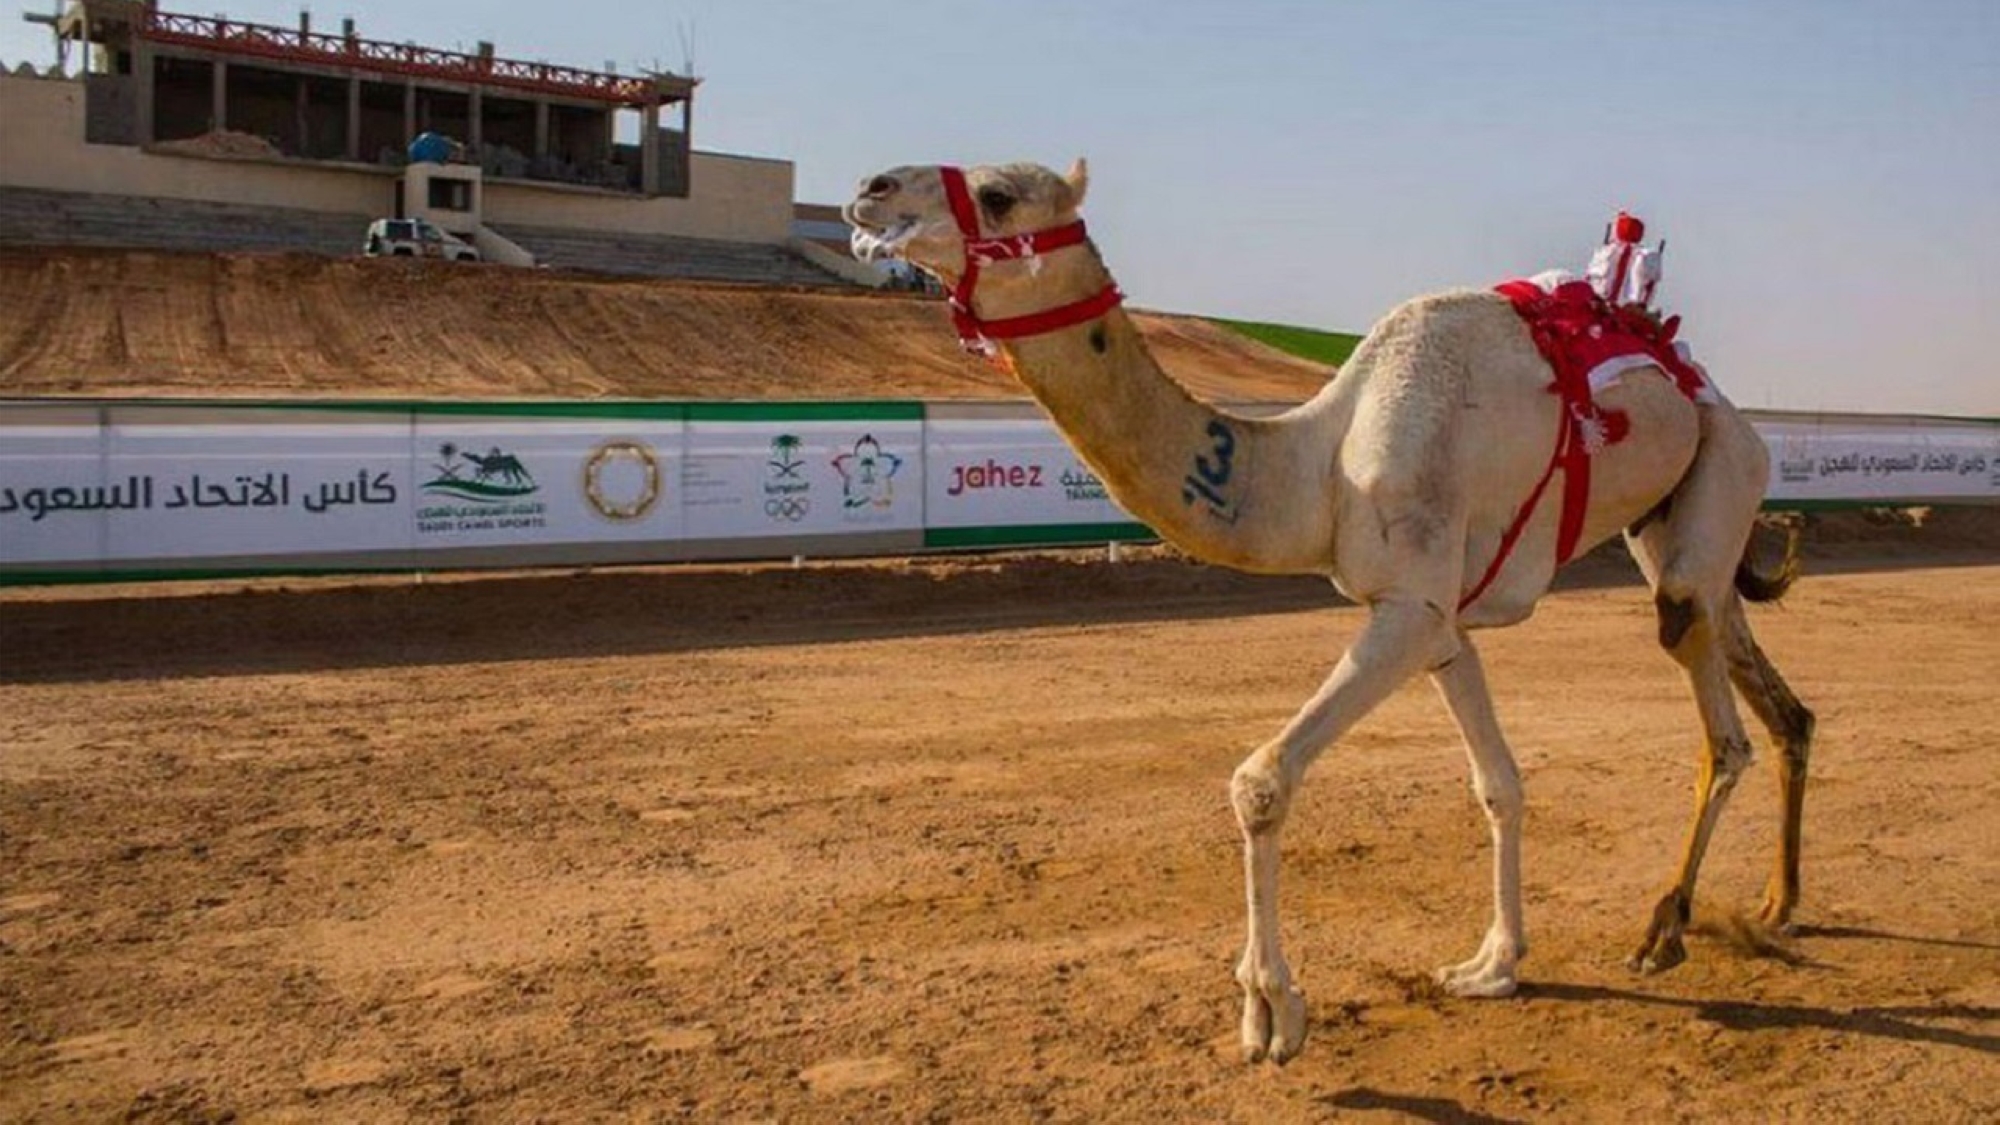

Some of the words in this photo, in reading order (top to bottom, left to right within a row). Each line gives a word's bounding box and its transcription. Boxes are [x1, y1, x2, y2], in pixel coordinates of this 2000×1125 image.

[165, 474, 289, 508] الاتحاد
[303, 470, 396, 512] كأس
[947, 458, 1043, 496] jahez
